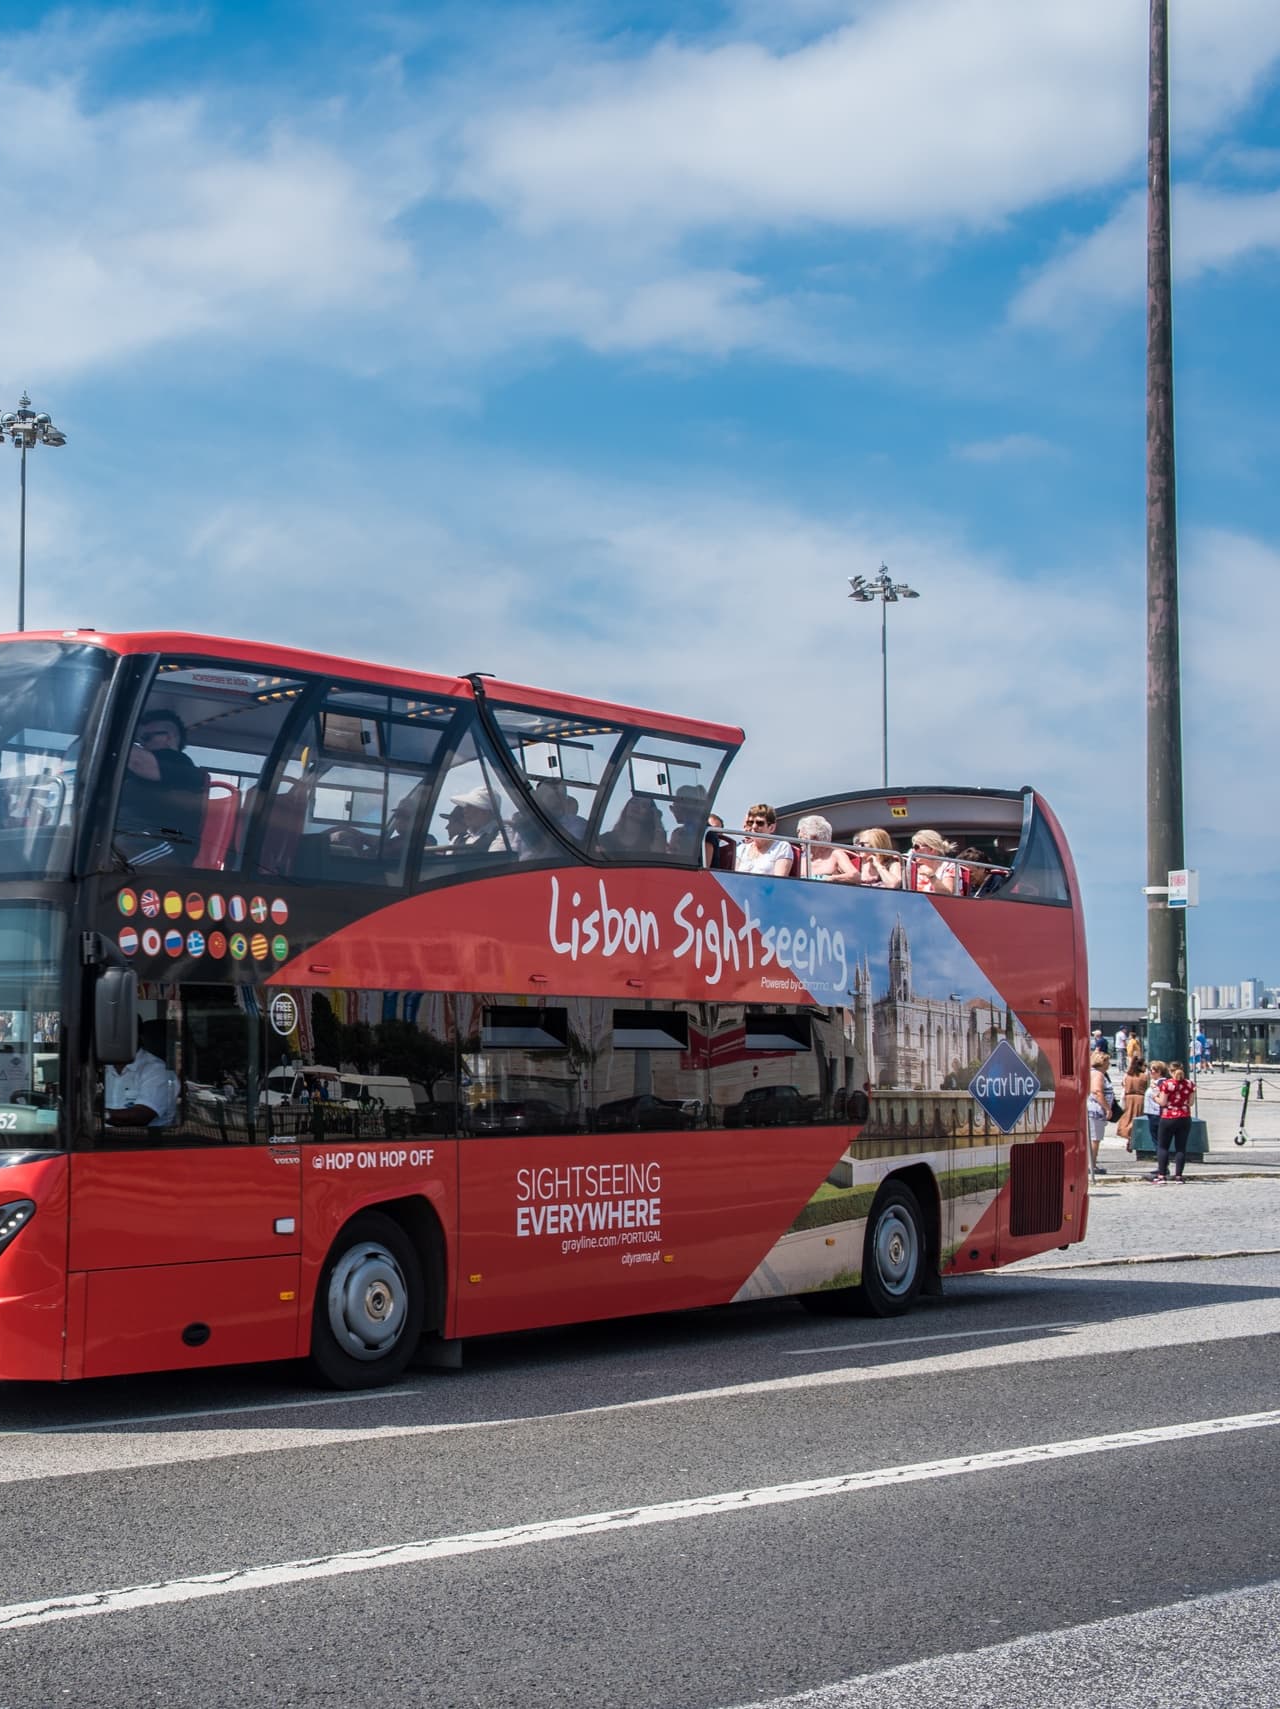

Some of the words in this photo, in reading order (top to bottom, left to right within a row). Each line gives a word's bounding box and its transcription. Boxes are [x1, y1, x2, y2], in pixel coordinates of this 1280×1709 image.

[549, 875, 659, 961] Lisbon
[673, 892, 847, 991] Sightseeing
[761, 977, 790, 990] Powered
[325, 1152, 354, 1170] HOP
[357, 1151, 376, 1168] ON
[380, 1150, 407, 1168] HOP
[410, 1149, 434, 1166] OFF
[517, 1162, 661, 1201] SIGHTSEEING
[517, 1198, 661, 1237] EVERYWHERE
